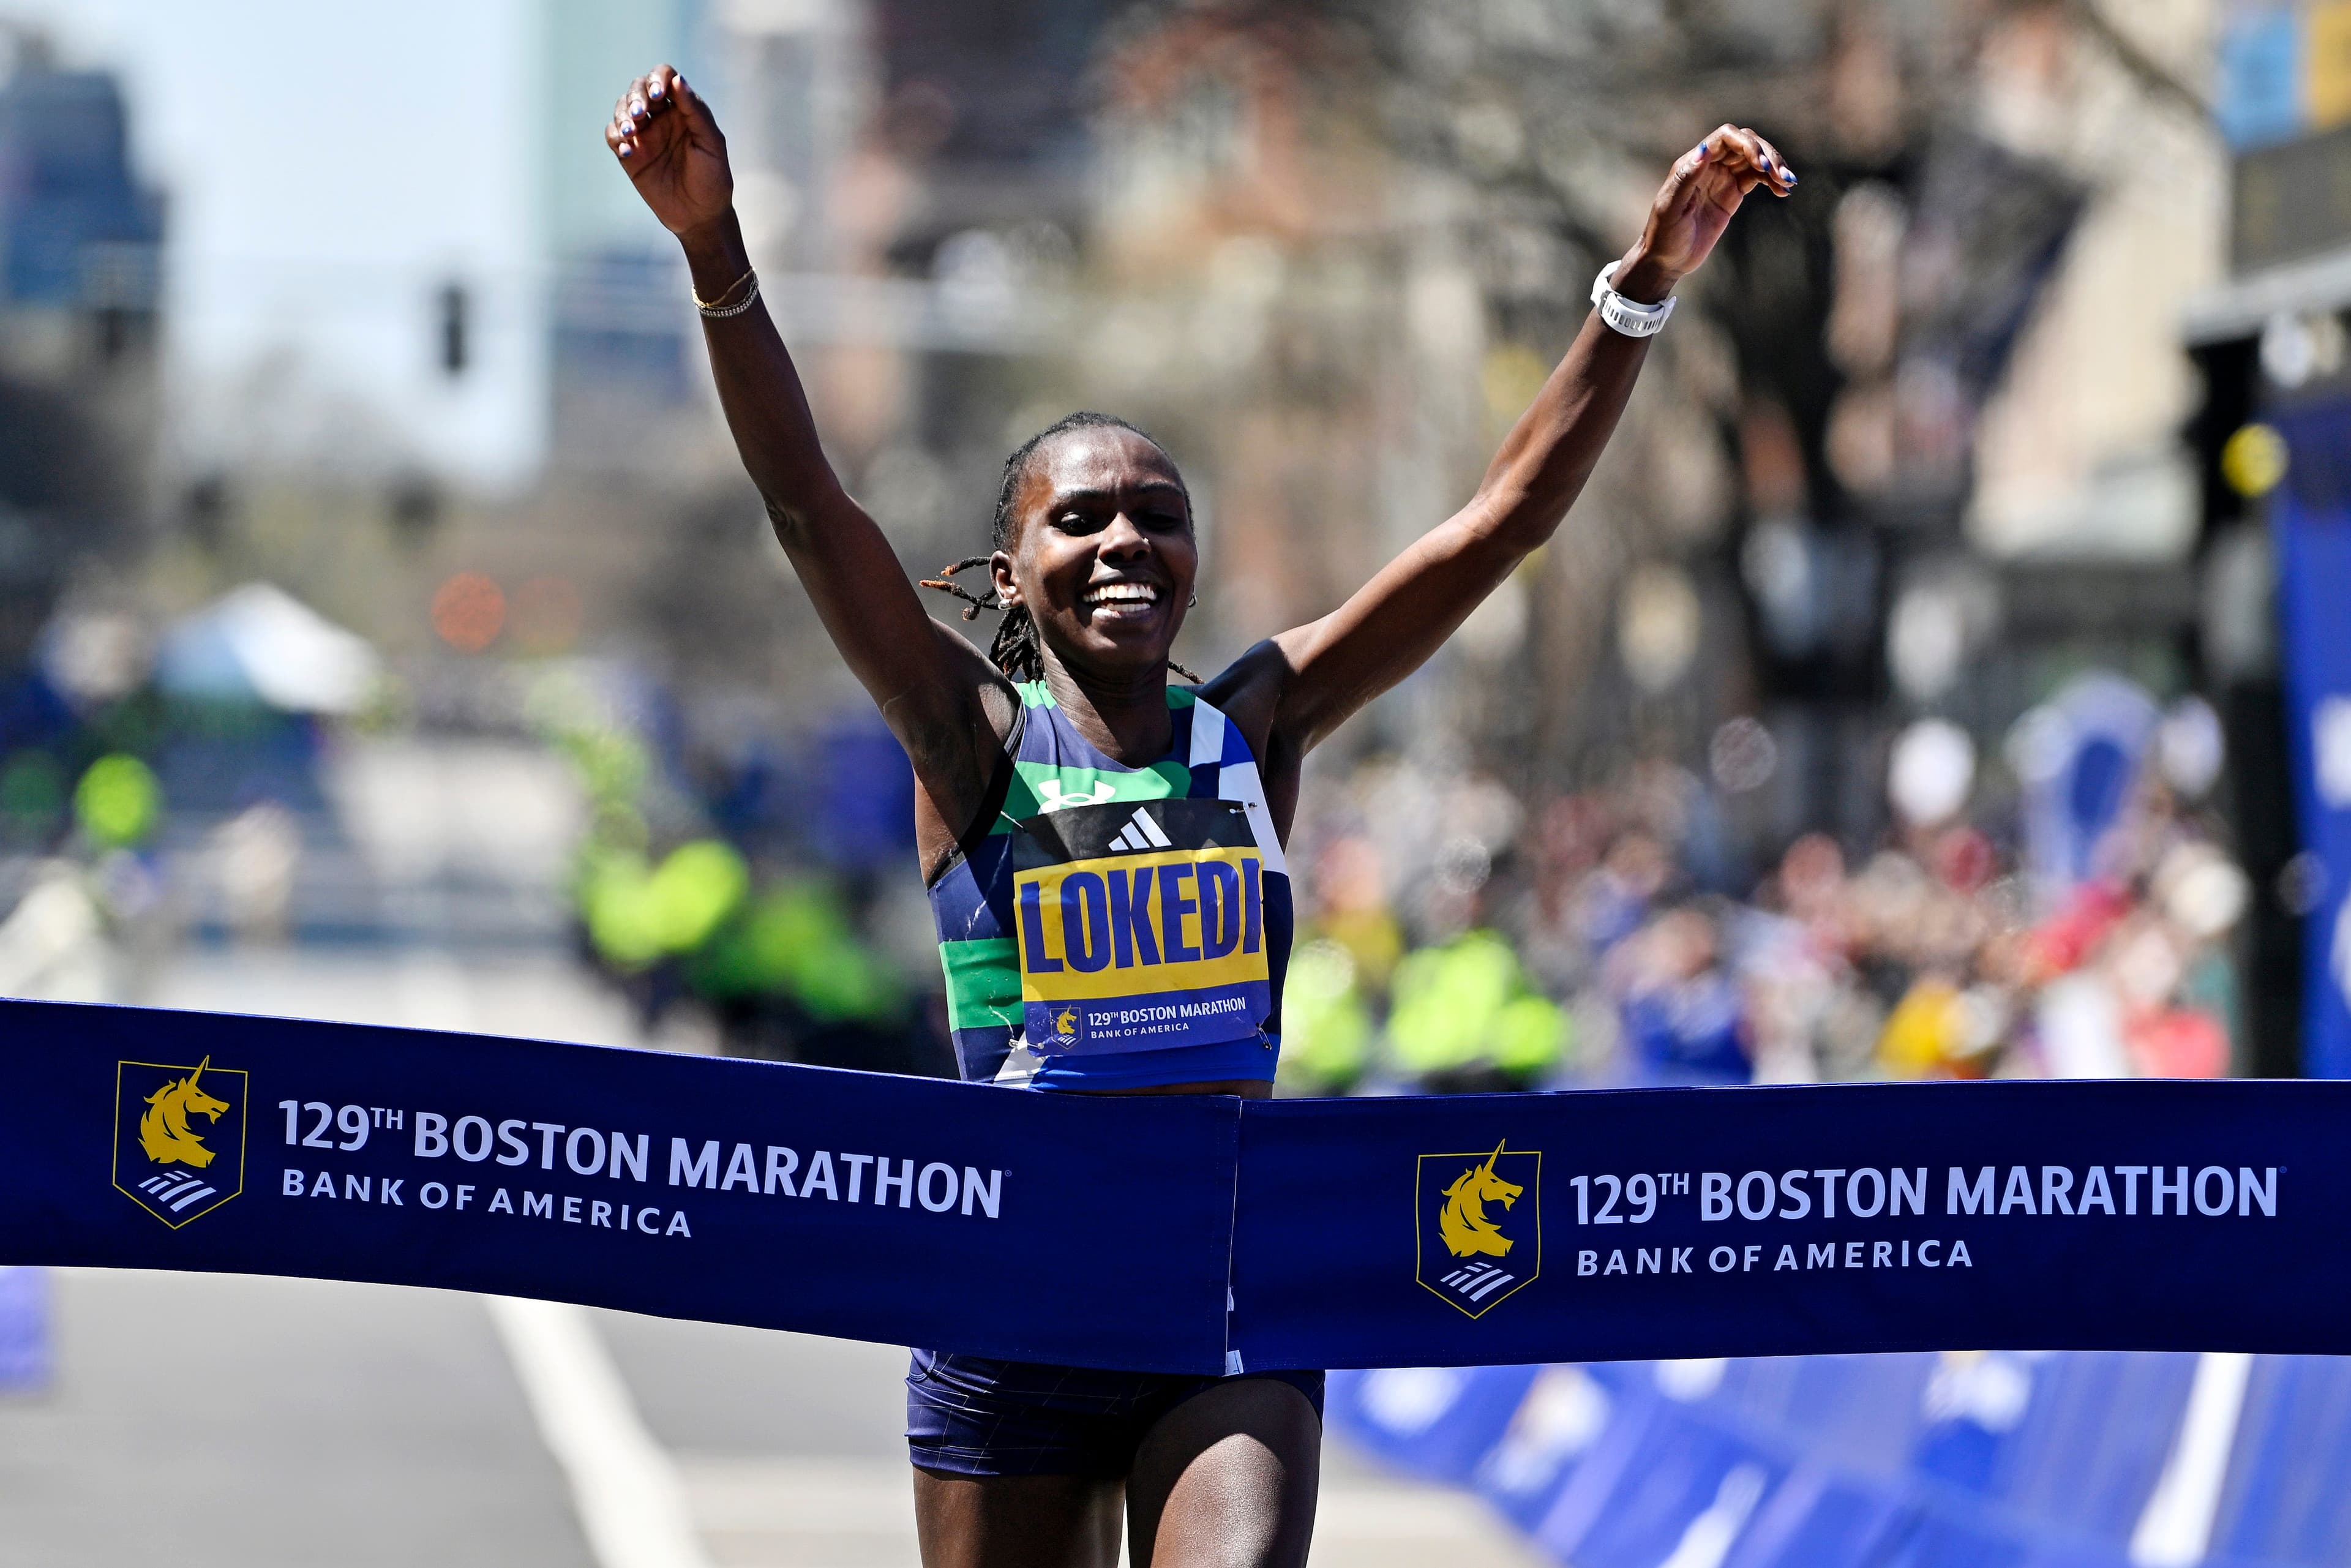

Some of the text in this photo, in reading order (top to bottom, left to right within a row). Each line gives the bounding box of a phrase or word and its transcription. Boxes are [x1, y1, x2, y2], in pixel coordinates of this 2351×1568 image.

[1020, 858, 1261, 973] LOKEDI
[1087, 996, 1247, 1027] 129TH BOSTON MARATHON
[1090, 1022, 1190, 1040] BANK OF AMERICA
[278, 1100, 403, 1152] 129TH
[413, 1111, 650, 1183] BOSTON
[282, 1169, 692, 1239] BANK OF AMERICA
[1569, 1165, 2278, 1226] 129TH BOSTON MARATHON
[1577, 1239, 1973, 1277] BANK OF AMERICA
